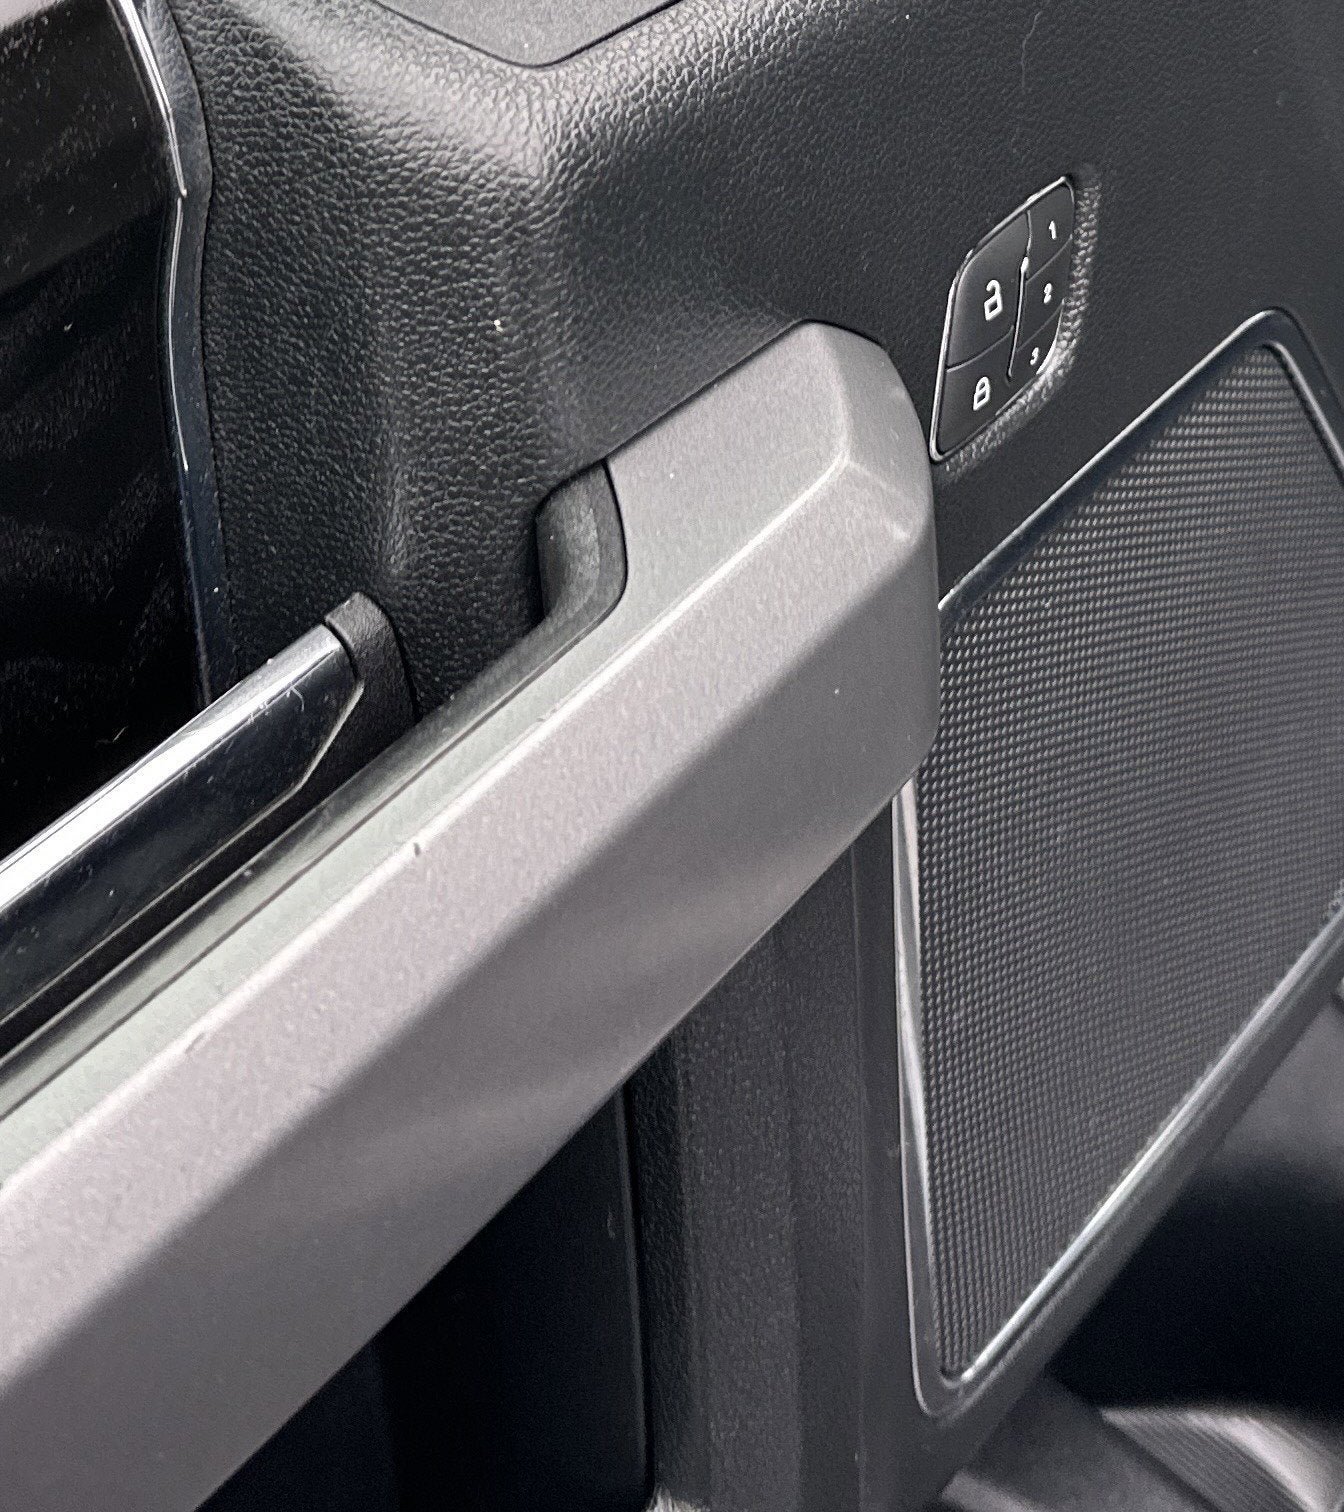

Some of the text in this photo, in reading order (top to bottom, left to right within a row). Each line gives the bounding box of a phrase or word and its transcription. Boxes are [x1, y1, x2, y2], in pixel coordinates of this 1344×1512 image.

[1048, 220, 1057, 240] 1
[1043, 282, 1053, 304] 2
[1029, 347, 1040, 366] 3
